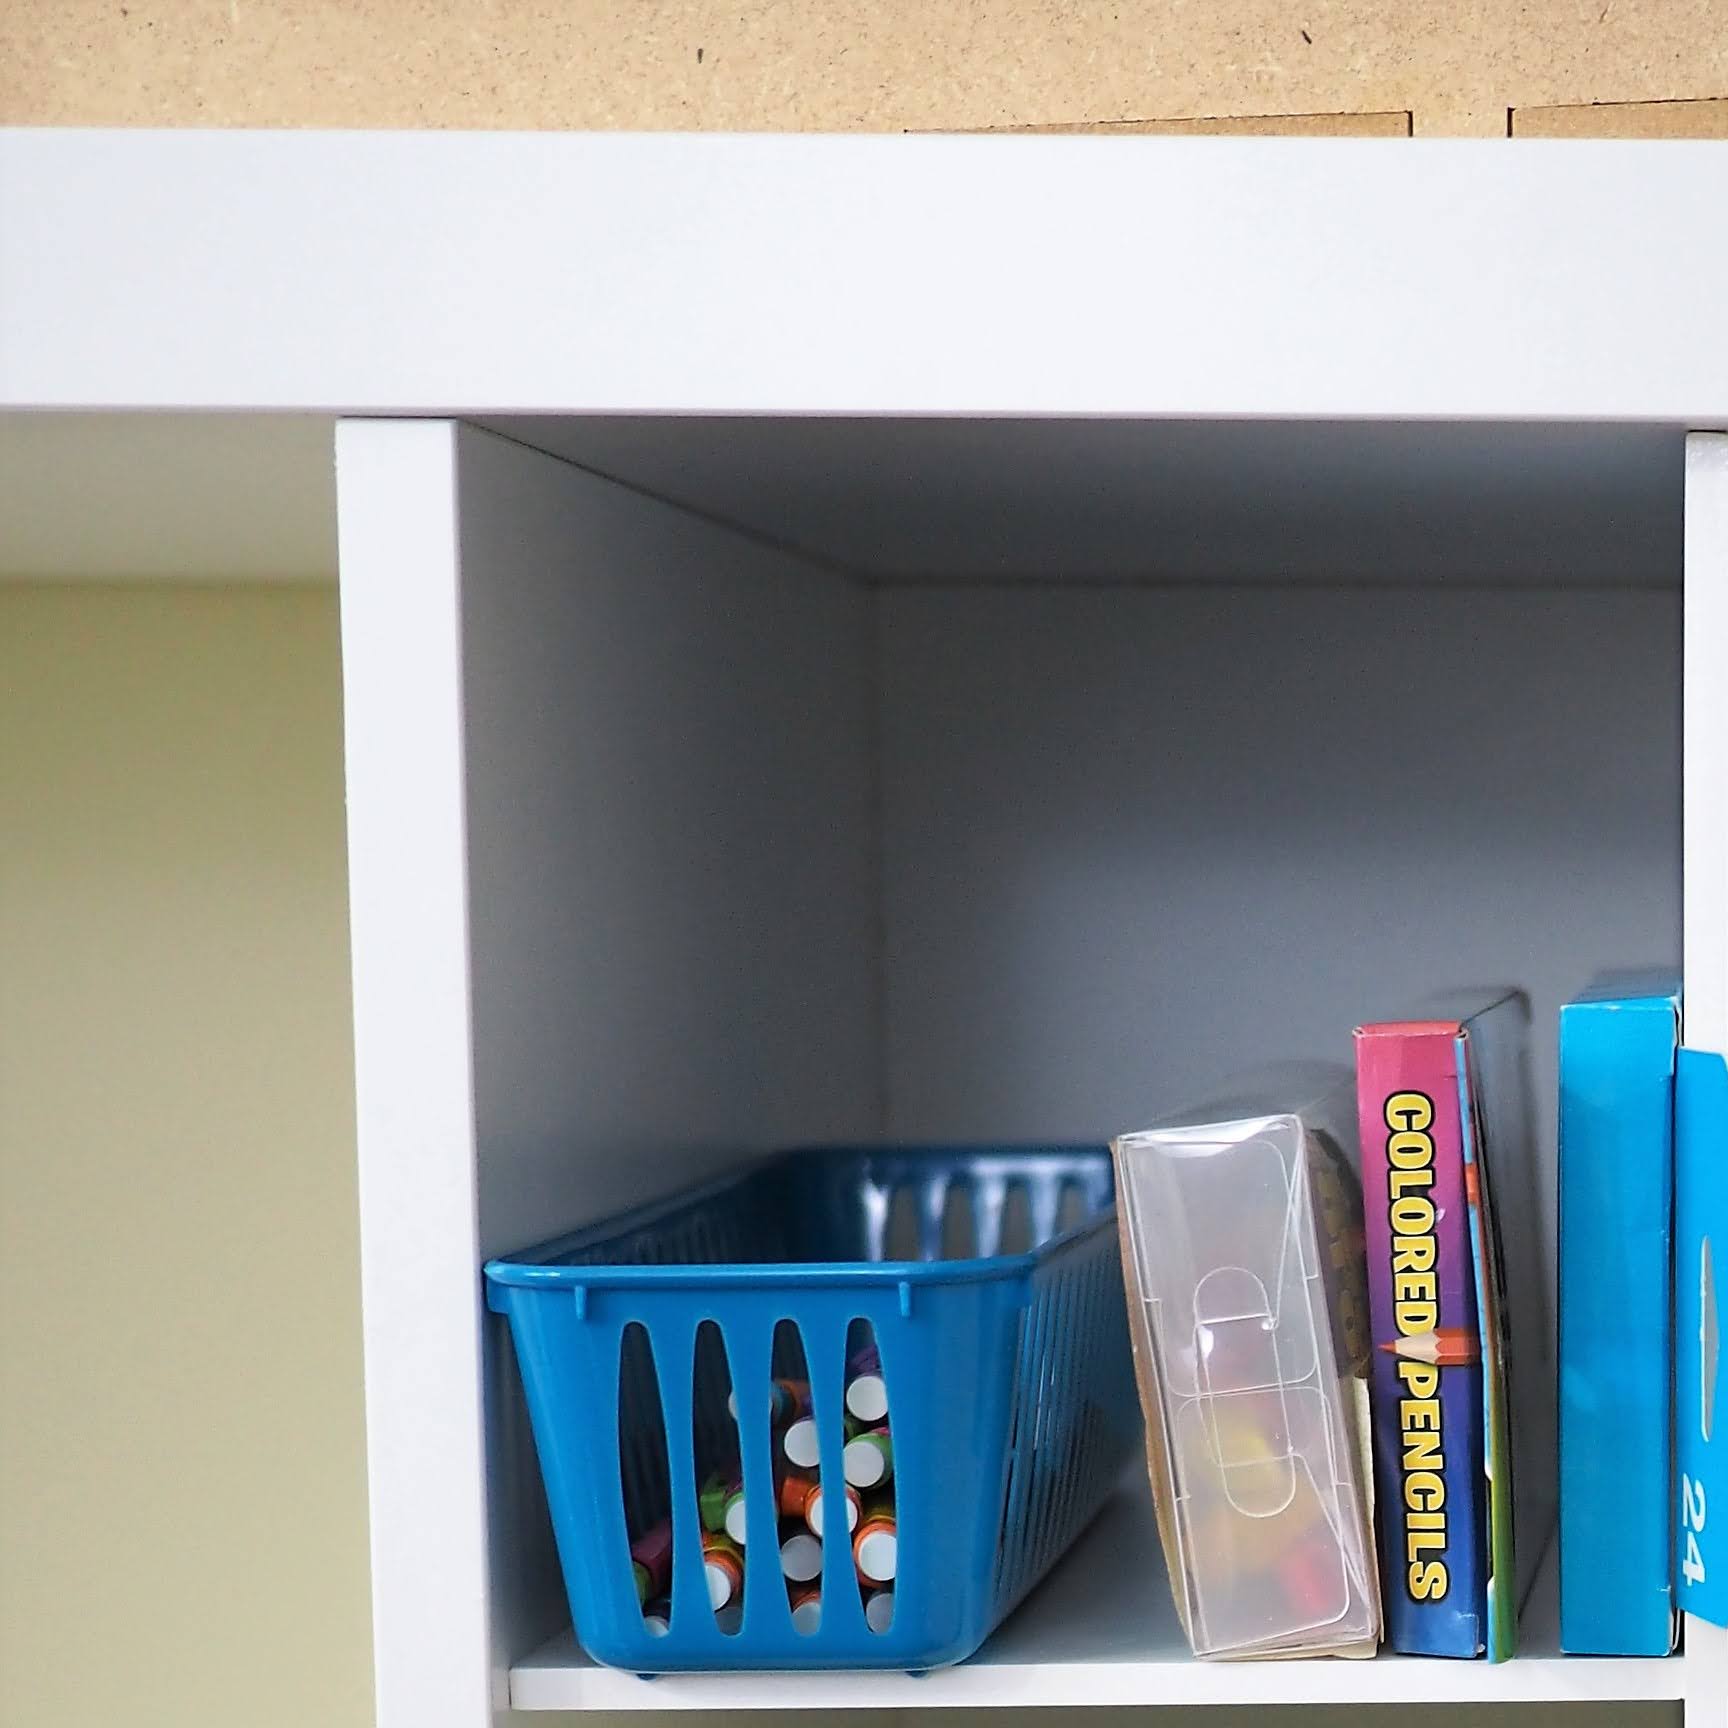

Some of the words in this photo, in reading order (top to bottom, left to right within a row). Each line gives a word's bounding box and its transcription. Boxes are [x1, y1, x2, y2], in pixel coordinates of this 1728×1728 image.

[1384, 1091, 1441, 1338] COLORED
[1398, 1361, 1448, 1600] PENCILS
[1682, 1472, 1706, 1586] 24
